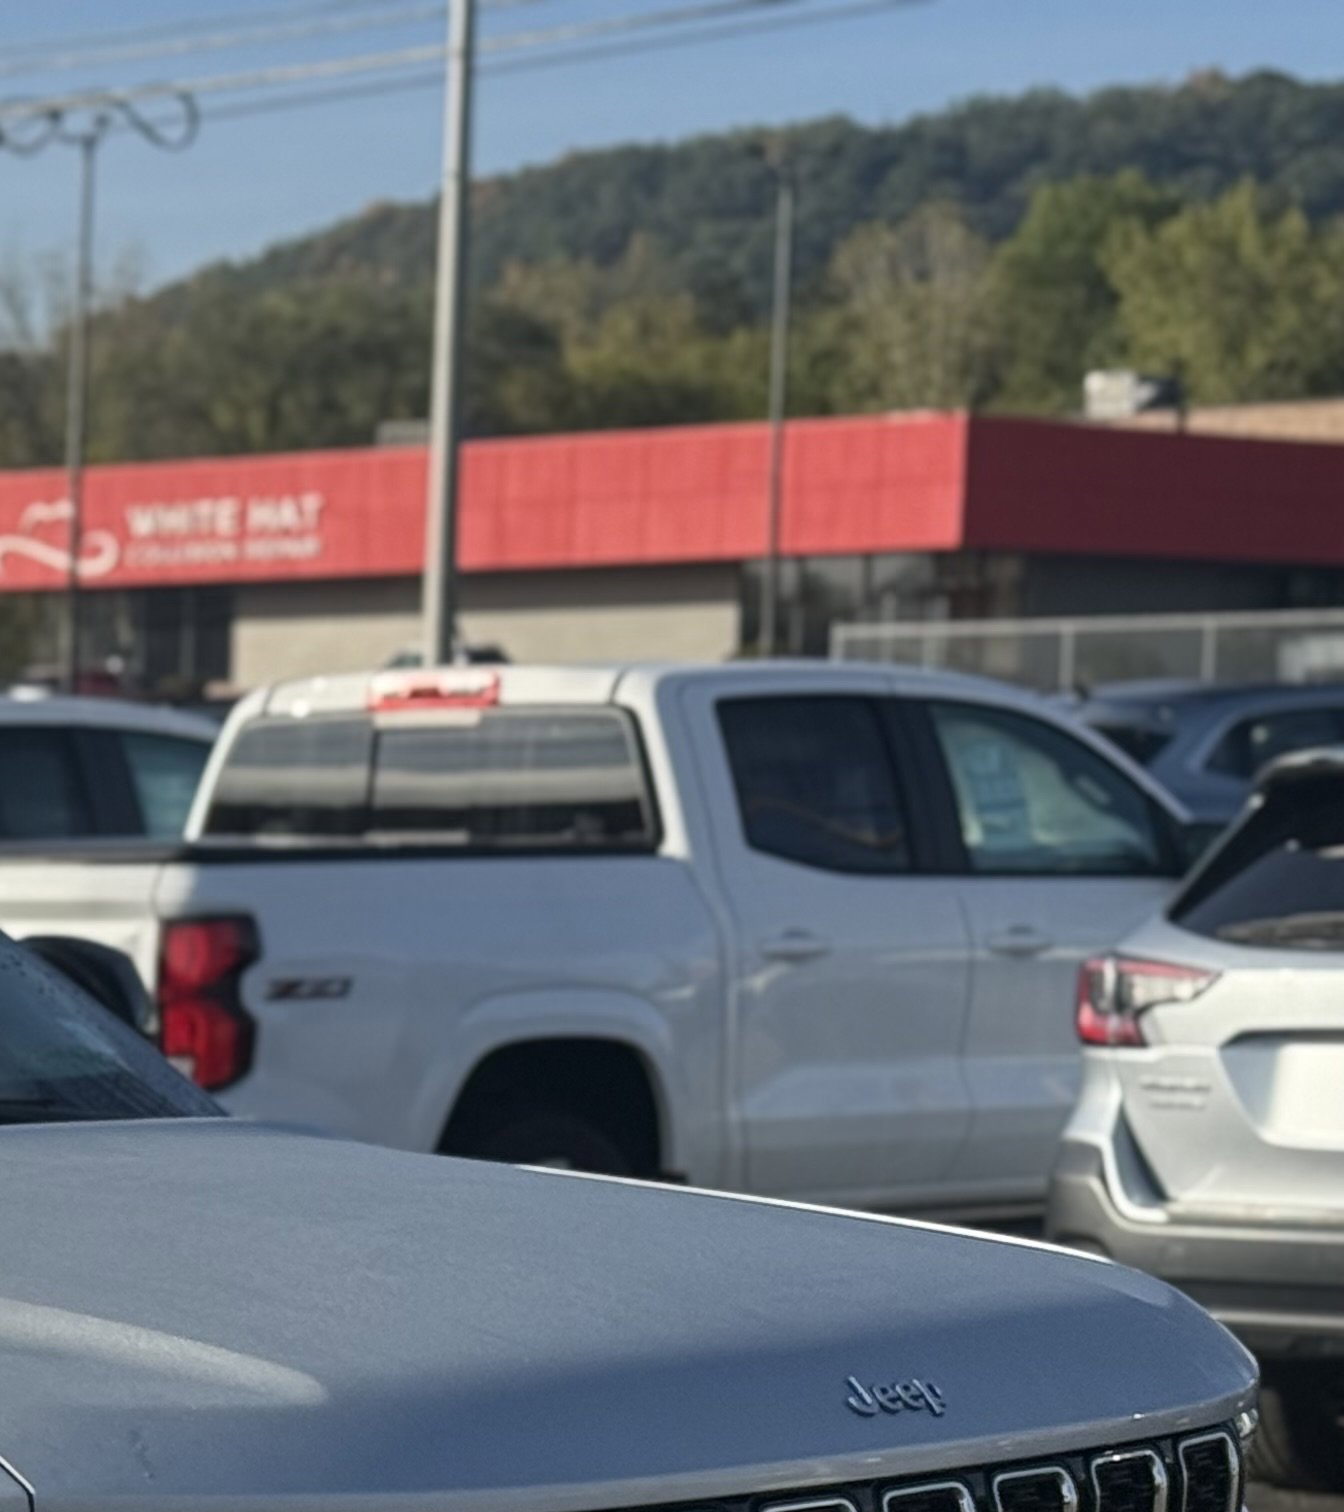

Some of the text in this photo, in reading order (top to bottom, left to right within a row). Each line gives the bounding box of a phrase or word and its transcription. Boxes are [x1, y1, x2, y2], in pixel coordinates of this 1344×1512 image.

[124, 492, 324, 538] WHITE HAT
[846, 1374, 946, 1418] Jeep
